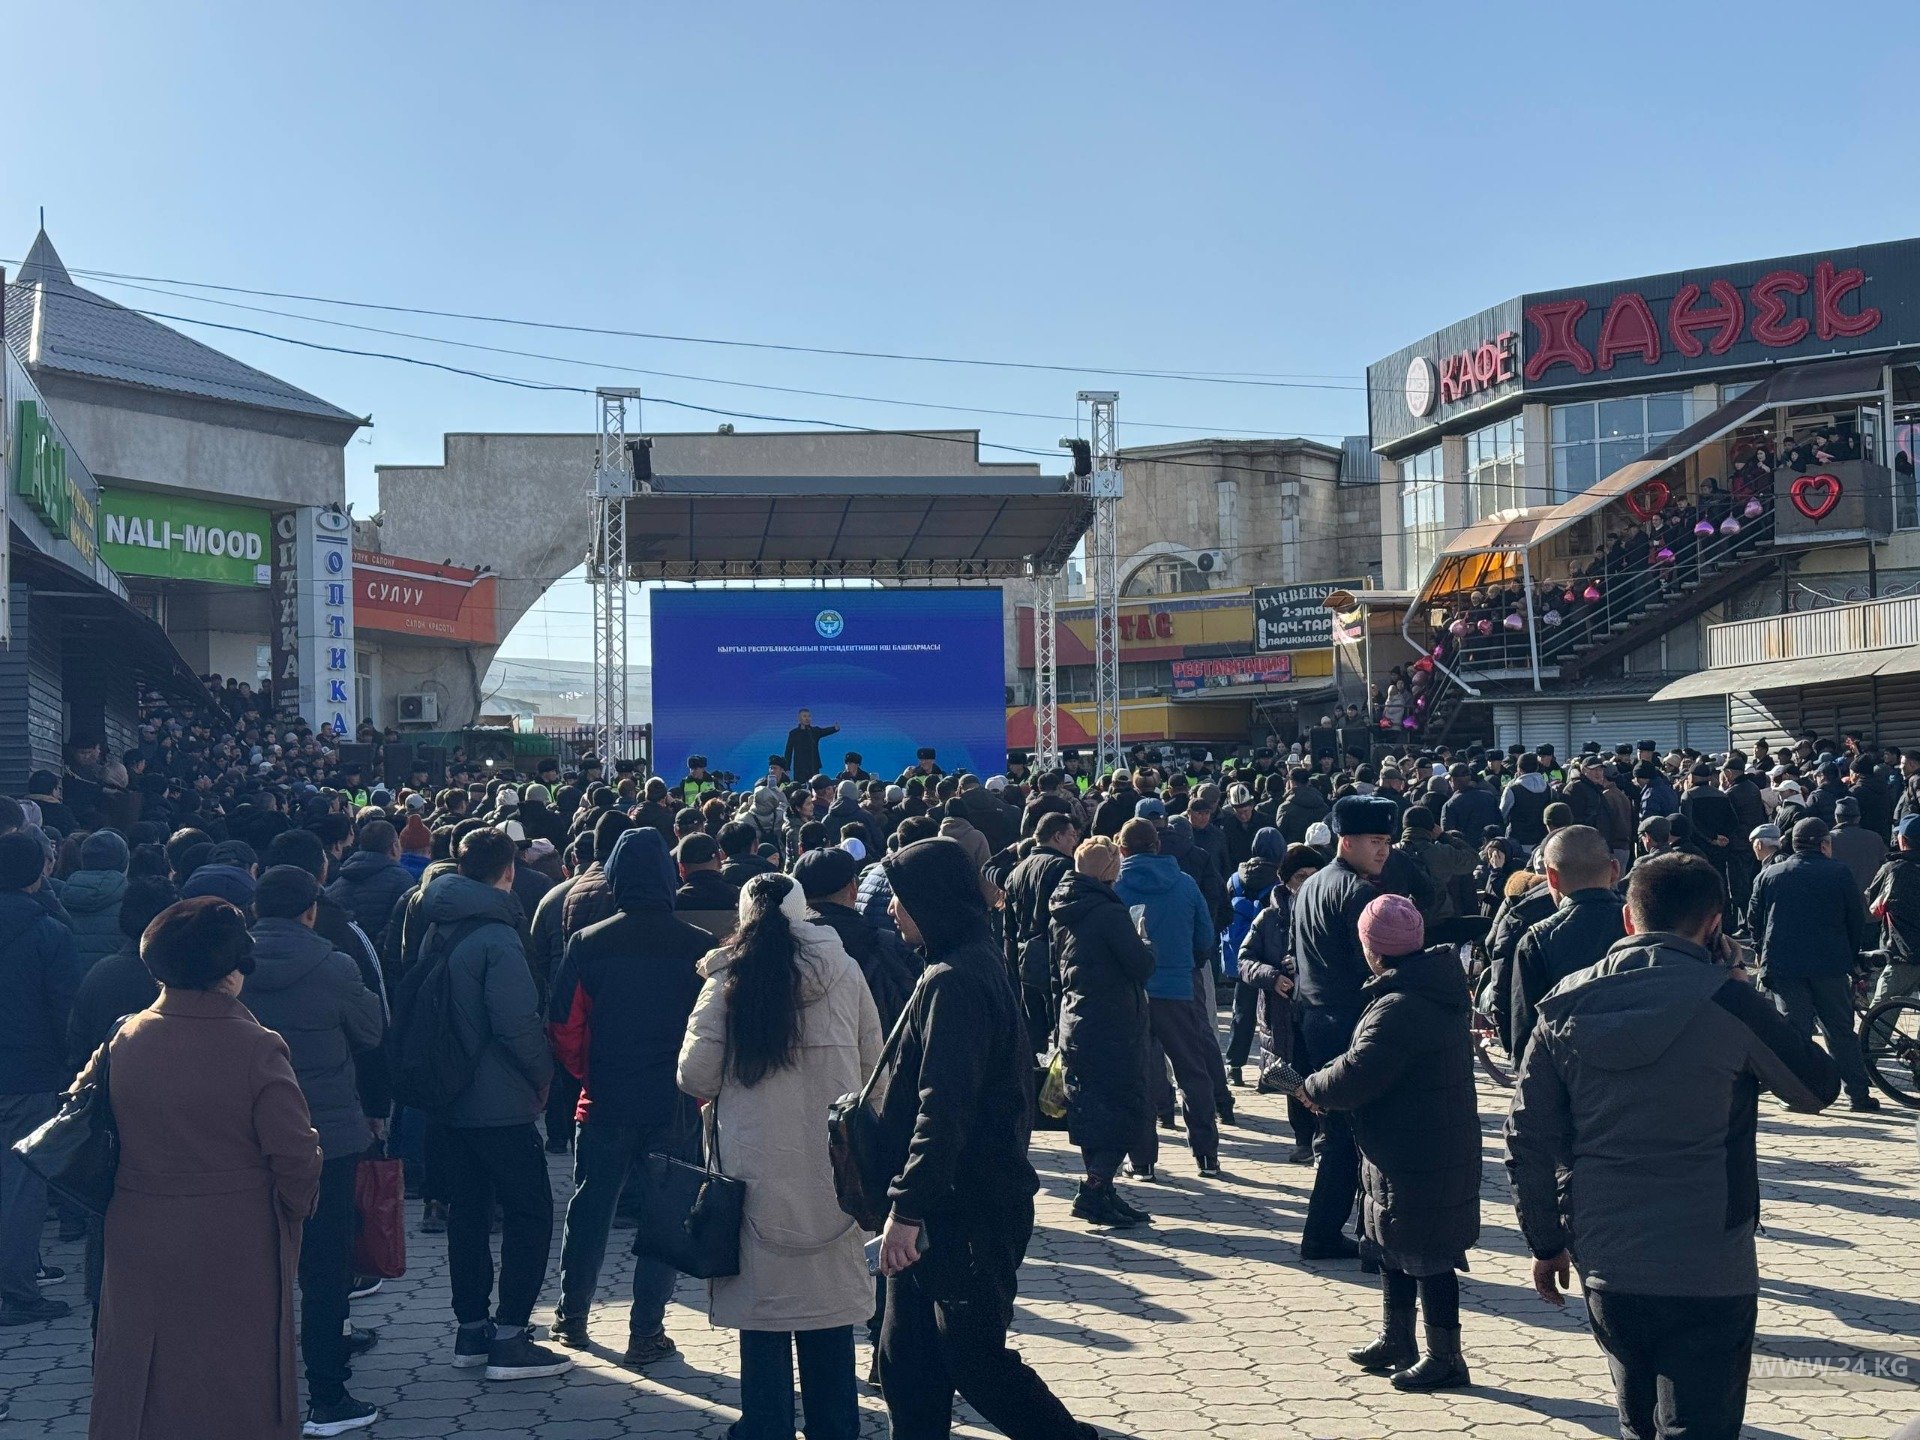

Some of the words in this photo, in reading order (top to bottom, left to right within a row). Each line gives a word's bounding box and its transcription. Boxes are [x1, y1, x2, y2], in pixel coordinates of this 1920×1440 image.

[1439, 331, 1516, 404] КАФЕ
[105, 513, 262, 561] NALI-MOOD
[367, 582, 423, 606] СУЛУУ
[1259, 587, 1340, 612] BARBERSH
[1268, 619, 1332, 634] ЧАЧ-ТАР
[326, 551, 348, 735] ОПТИКА
[1172, 656, 1290, 678] РЕСТАВРАЦИЯ
